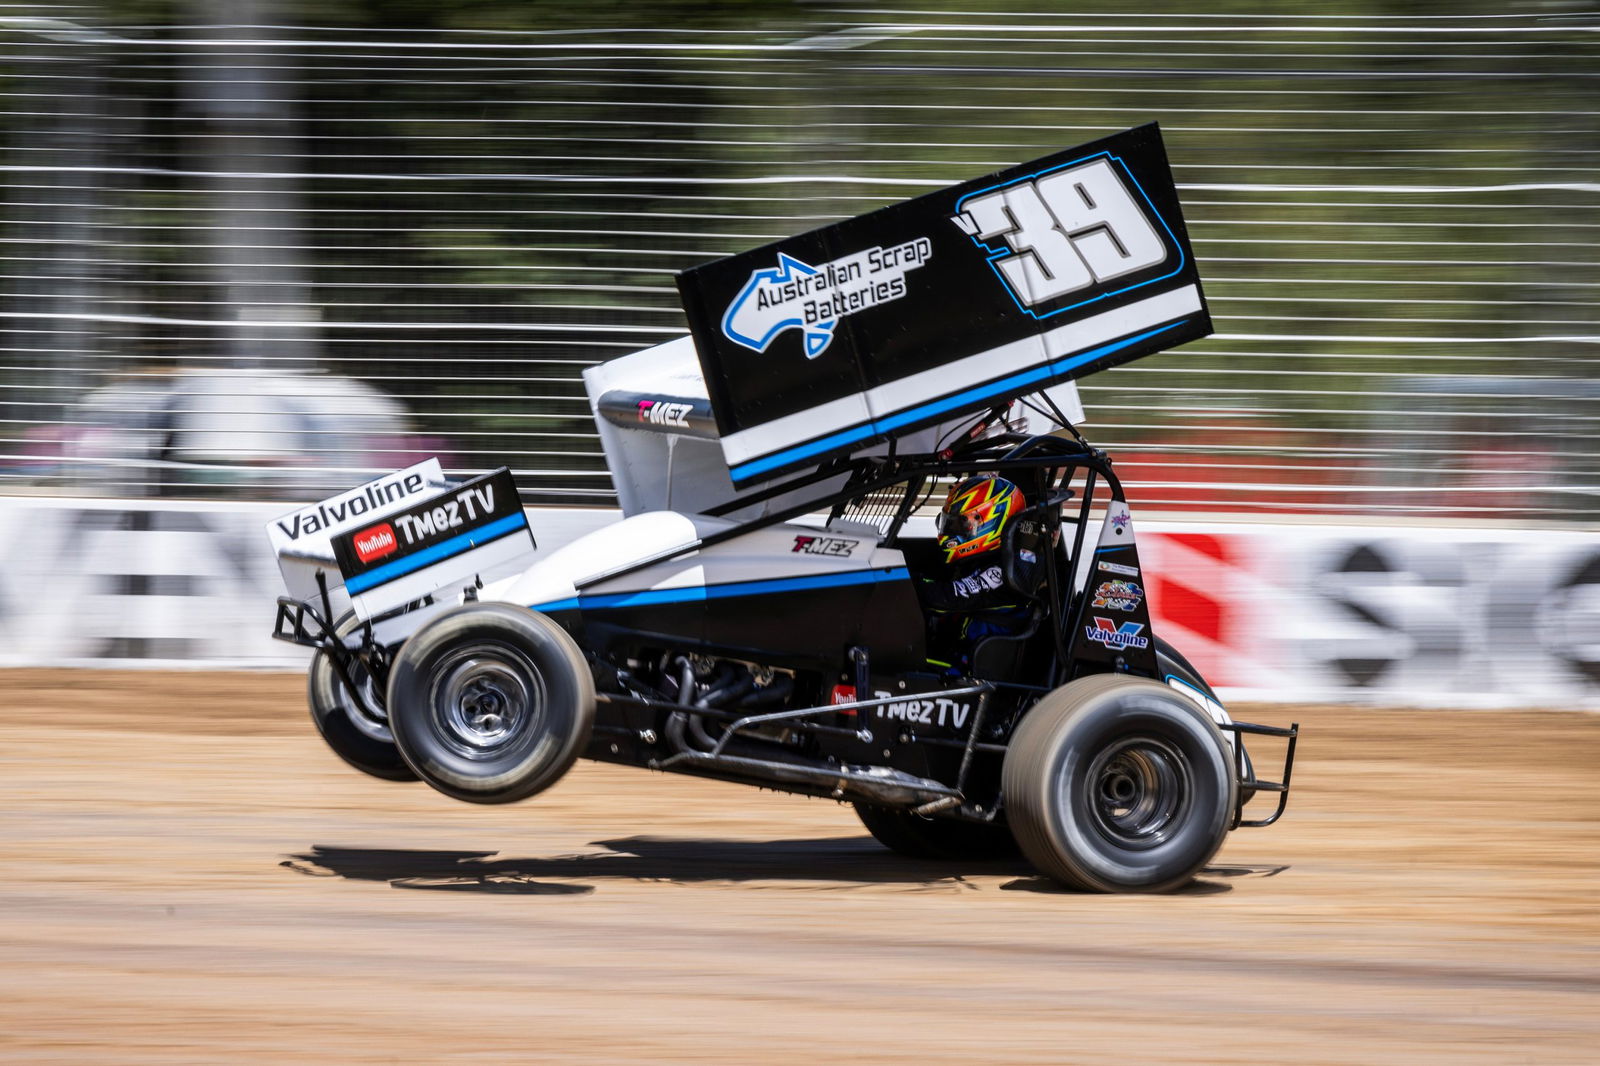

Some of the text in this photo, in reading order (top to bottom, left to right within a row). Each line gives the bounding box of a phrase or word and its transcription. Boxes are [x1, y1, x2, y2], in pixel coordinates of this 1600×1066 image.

[758, 239, 929, 311] Australian Scrap
[804, 277, 903, 325] Batteries
[278, 473, 423, 540] Valvoline
[357, 532, 393, 555] YouTube
[1086, 626, 1147, 648] Valvoline
